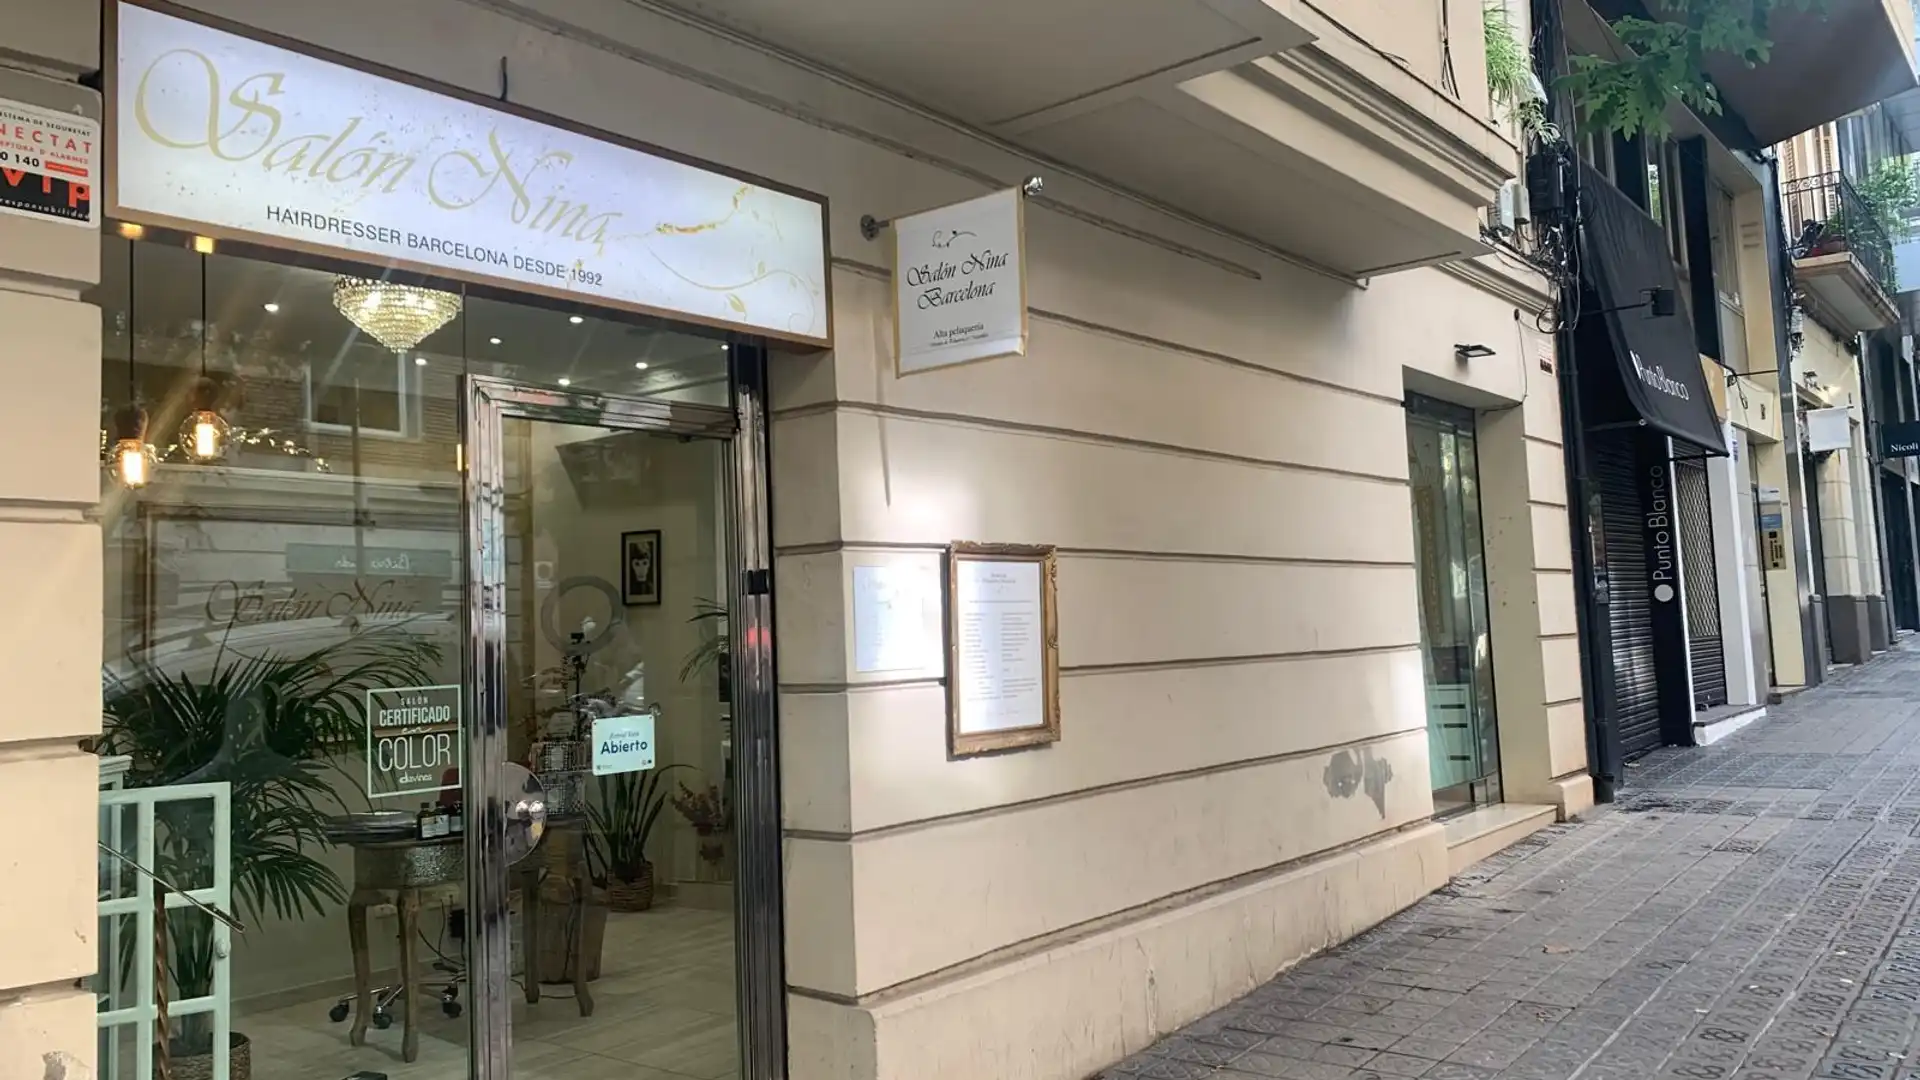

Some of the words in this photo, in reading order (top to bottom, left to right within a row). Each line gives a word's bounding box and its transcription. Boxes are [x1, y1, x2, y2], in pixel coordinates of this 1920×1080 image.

[15, 154, 39, 167] 140
[134, 48, 416, 193] Salón
[428, 127, 623, 255] Nina
[266, 205, 401, 245] HAIRDRESSER
[407, 233, 509, 267] BARCELONA
[513, 256, 566, 278] DESDE
[571, 268, 603, 286] 1992
[906, 260, 956, 287] Salón
[961, 249, 1009, 276] Nina
[917, 280, 996, 310] Barcelona
[1646, 465, 1668, 528] Blanco
[1652, 531, 1673, 580] Punto
[379, 705, 450, 727] CERTIFICADO
[401, 726, 433, 735] en
[378, 733, 451, 771] COLOR
[600, 740, 648, 754] Abierto
